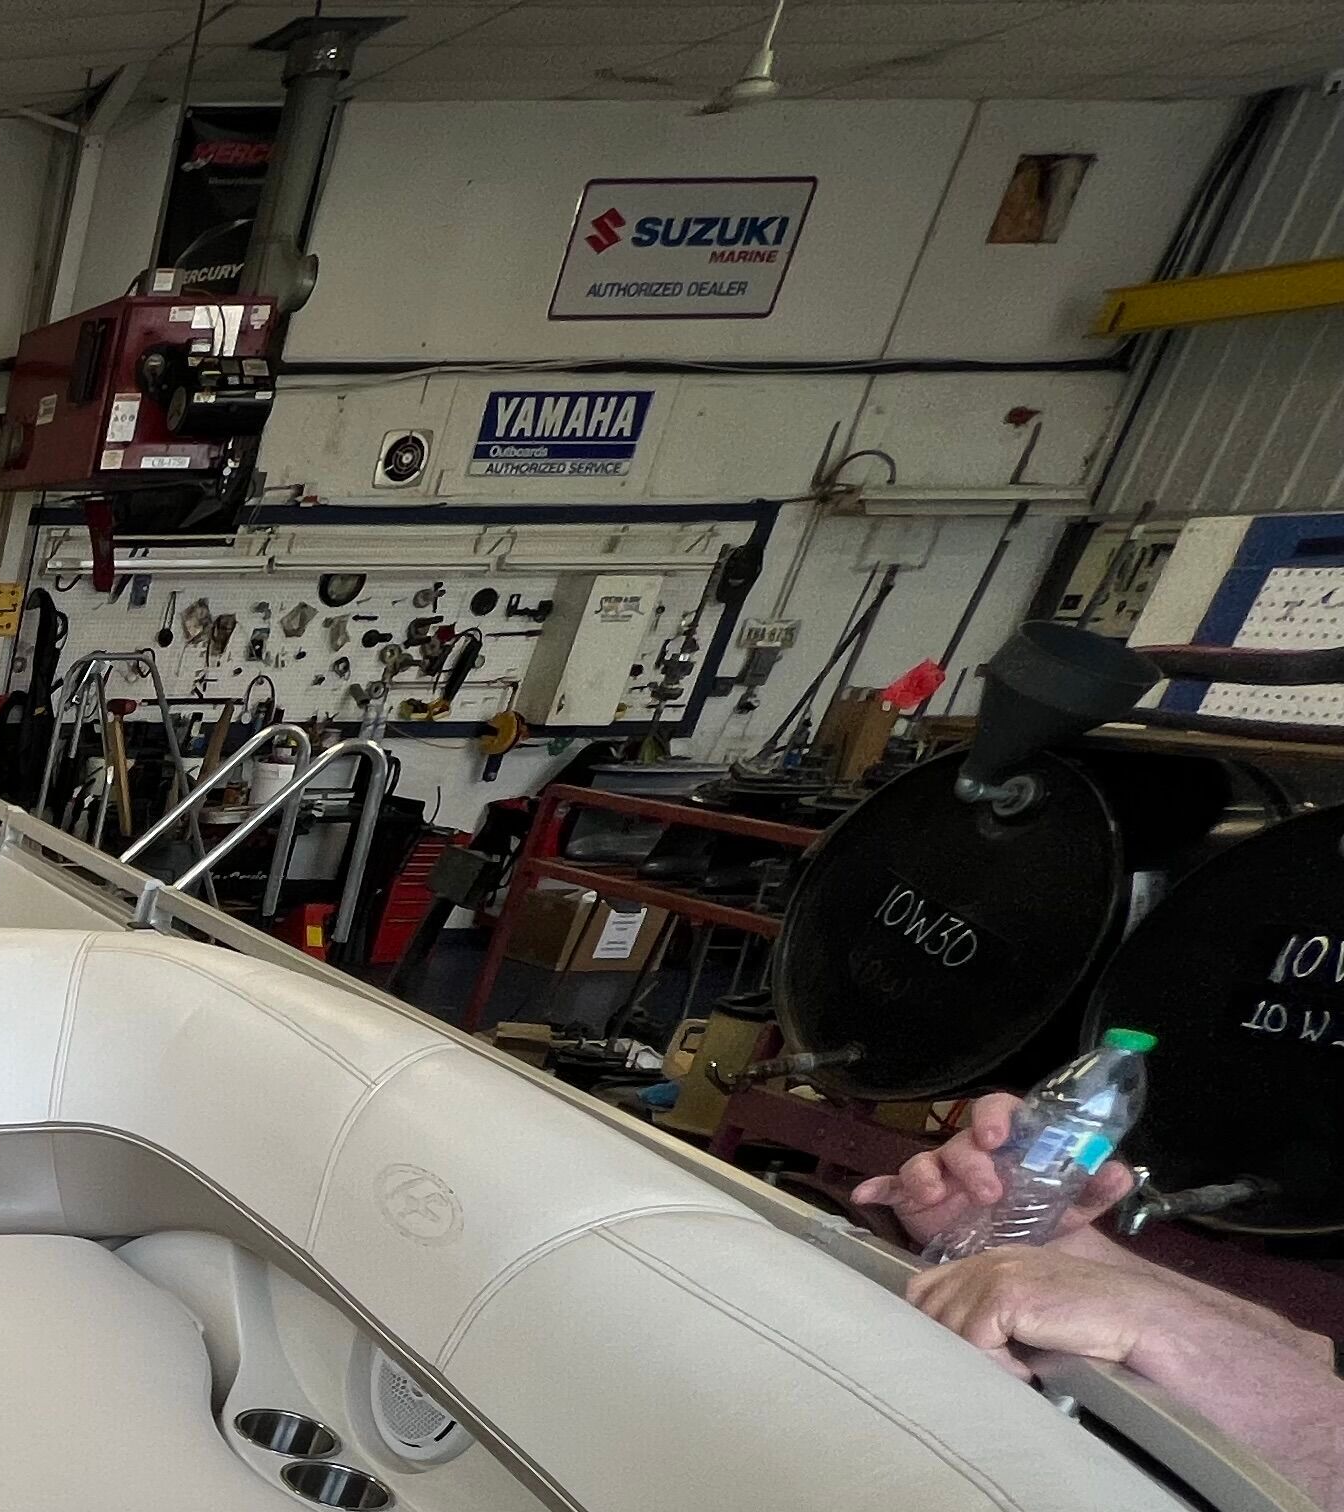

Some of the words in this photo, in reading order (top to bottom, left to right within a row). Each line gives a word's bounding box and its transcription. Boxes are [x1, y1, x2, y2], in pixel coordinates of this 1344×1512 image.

[631, 216, 790, 247] SUZUKI
[708, 250, 777, 264] MARINE
[184, 262, 245, 284] ERCURY
[586, 281, 683, 297] AUTHORIZED
[686, 281, 749, 297] DEALER
[495, 396, 637, 437] YAMAHA
[489, 445, 549, 458] Outboards
[485, 462, 566, 475] AUTHORIZED
[568, 462, 622, 474] SERVICE
[874, 884, 978, 967] 10W30
